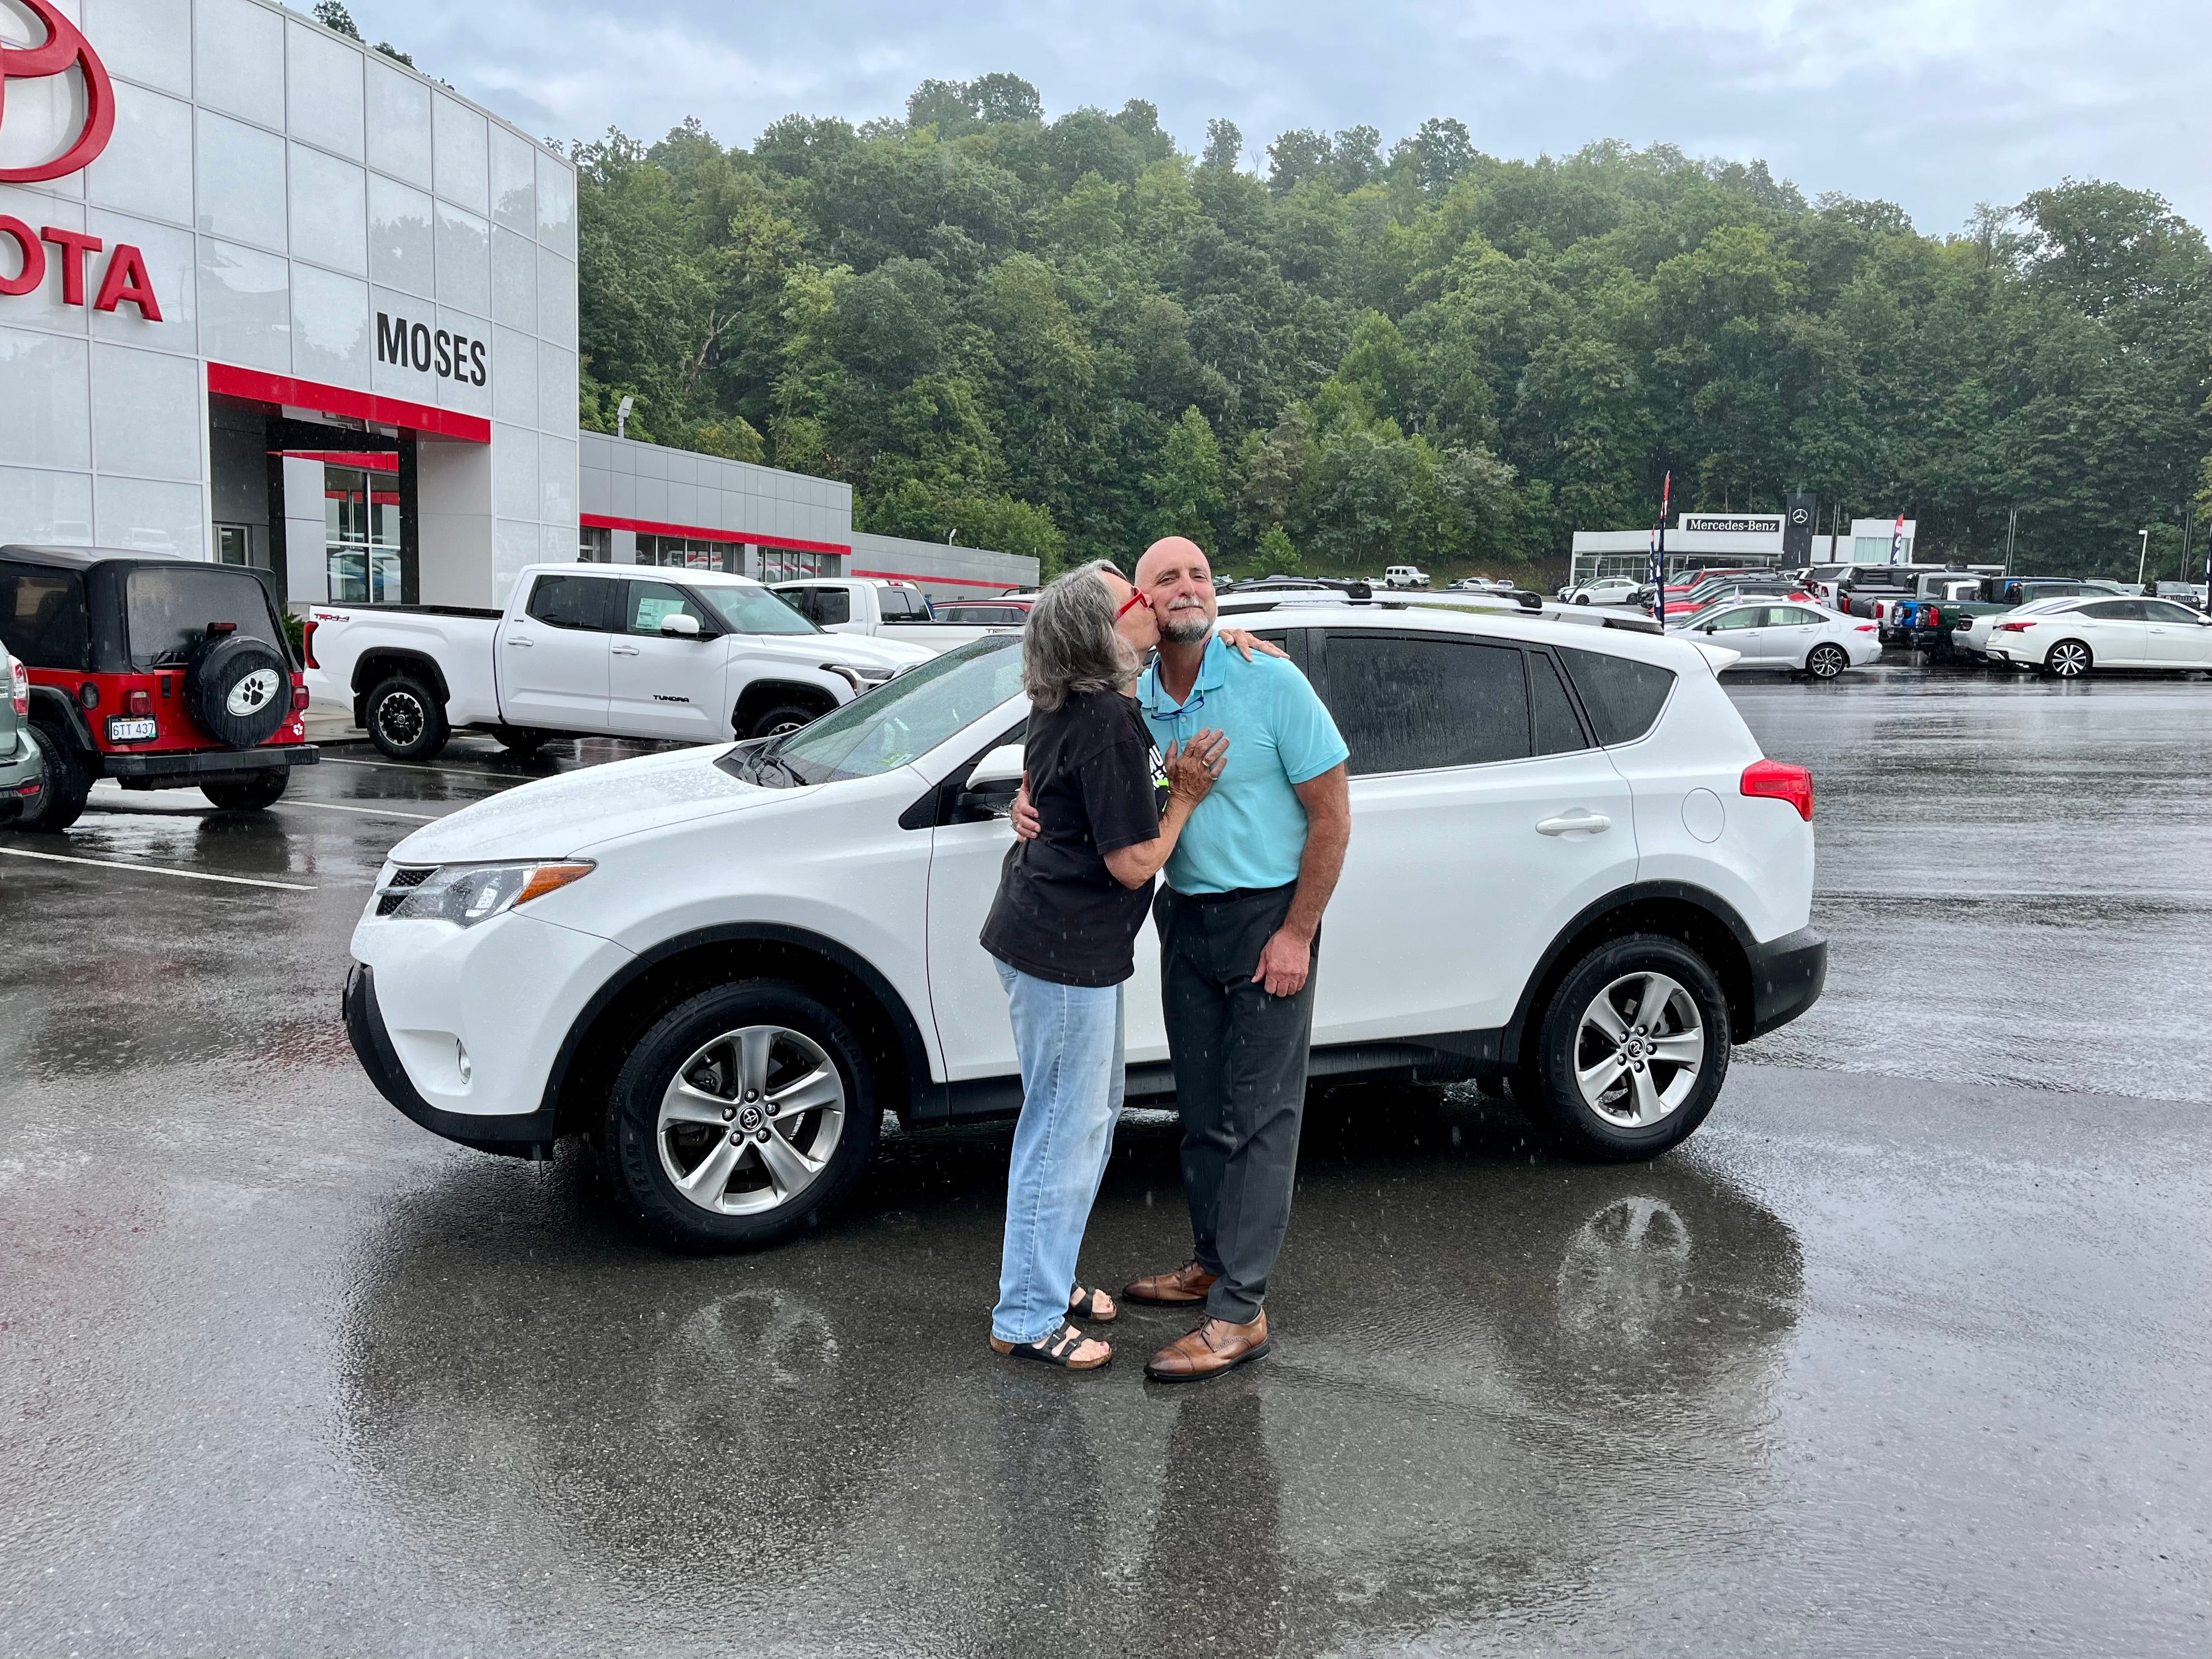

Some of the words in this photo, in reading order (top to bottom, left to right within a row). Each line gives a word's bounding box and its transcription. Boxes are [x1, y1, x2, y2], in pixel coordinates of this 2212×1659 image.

[376, 311, 486, 387] MOSES
[1690, 520, 1776, 531] Mercedes-Benz
[652, 694, 690, 703] TUNDRA
[113, 724, 131, 736] 6TT
[136, 723, 154, 734] 437
